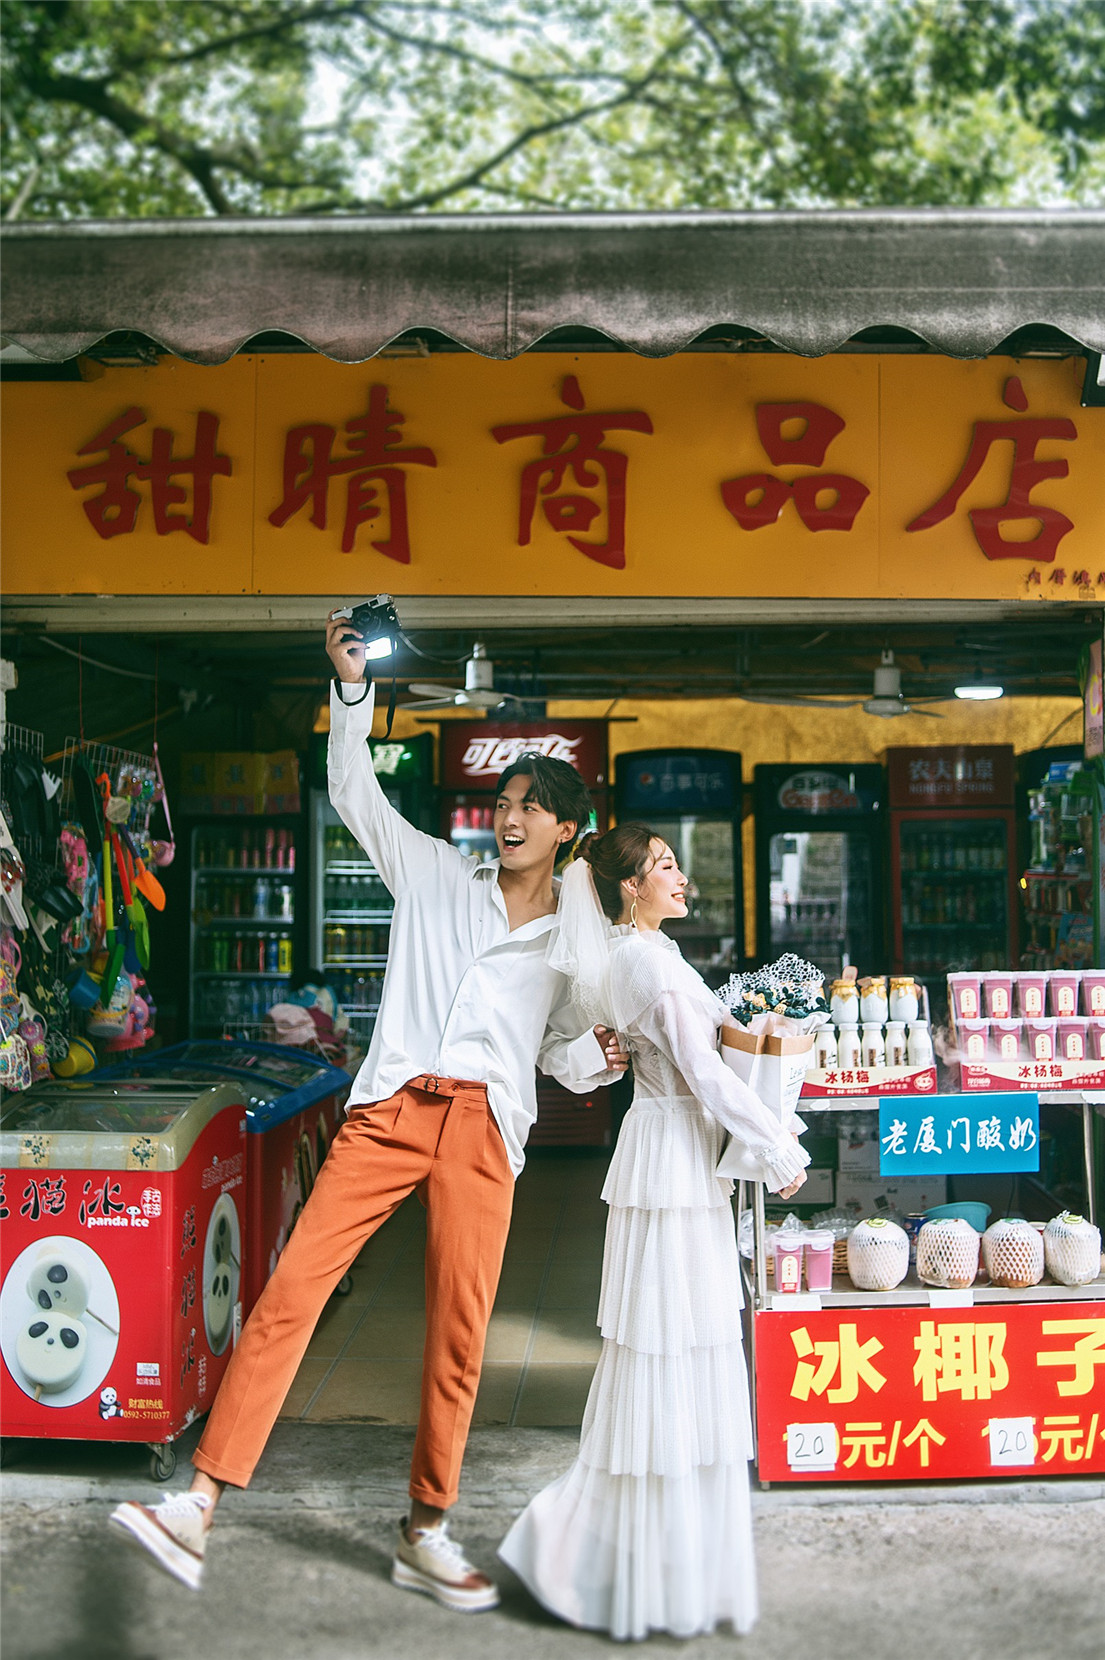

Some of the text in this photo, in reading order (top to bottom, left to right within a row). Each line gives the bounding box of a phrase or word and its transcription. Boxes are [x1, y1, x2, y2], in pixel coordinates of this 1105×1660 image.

[67, 375, 1078, 570] 甜晴商品店
[825, 1070, 870, 1084] 冰杨梅
[1017, 1064, 1063, 1079] 冰杨梅
[881, 1115, 1037, 1156] 老厦门酸奶
[0, 1173, 125, 1226] 猫冰
[87, 1214, 150, 1228] panda ice
[790, 1318, 1105, 1404] 冰椰子
